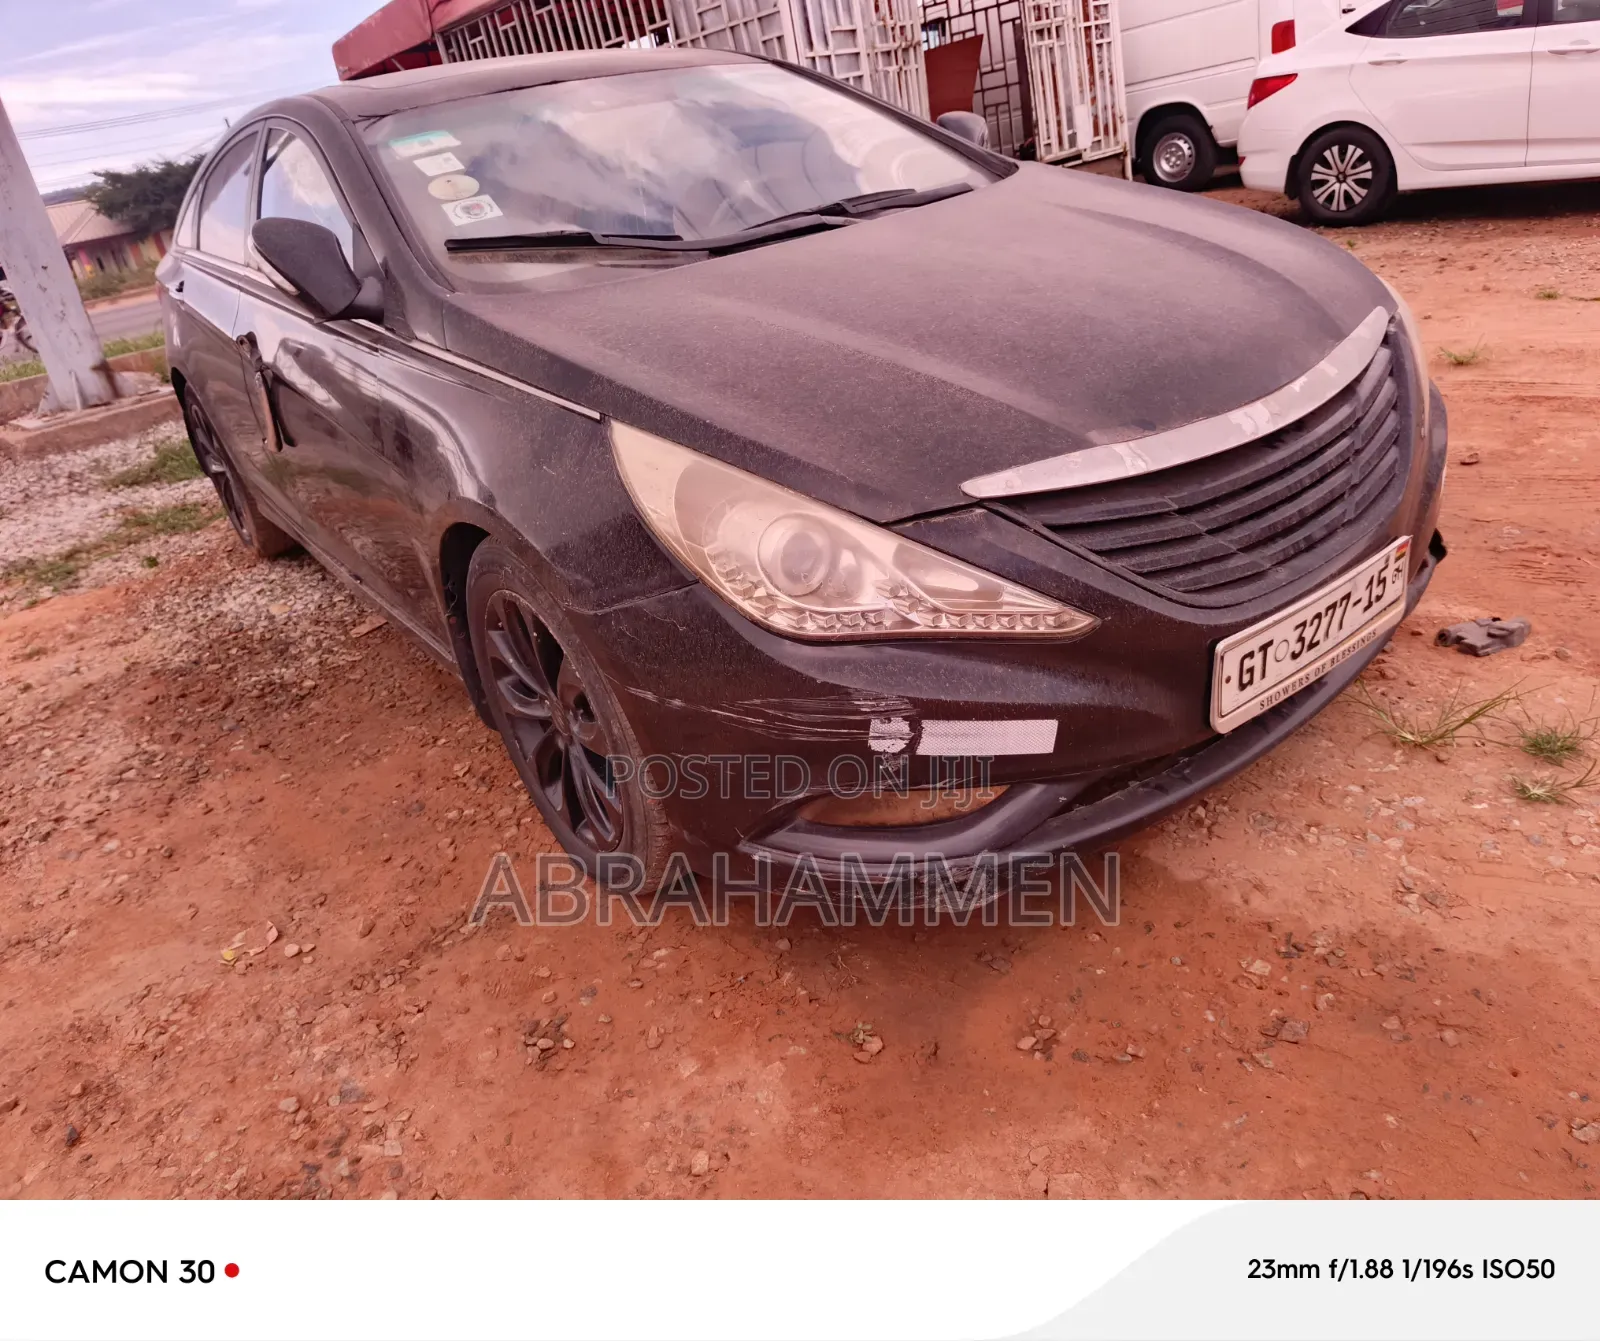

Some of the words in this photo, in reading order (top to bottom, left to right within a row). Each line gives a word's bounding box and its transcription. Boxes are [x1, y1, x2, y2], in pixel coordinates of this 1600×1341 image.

[1238, 639, 1274, 692] GT
[1290, 565, 1389, 661] 3277-15
[1259, 670, 1310, 711] SHOWERS
[1314, 664, 1327, 677] OF
[1330, 630, 1378, 668] BLESSINGS
